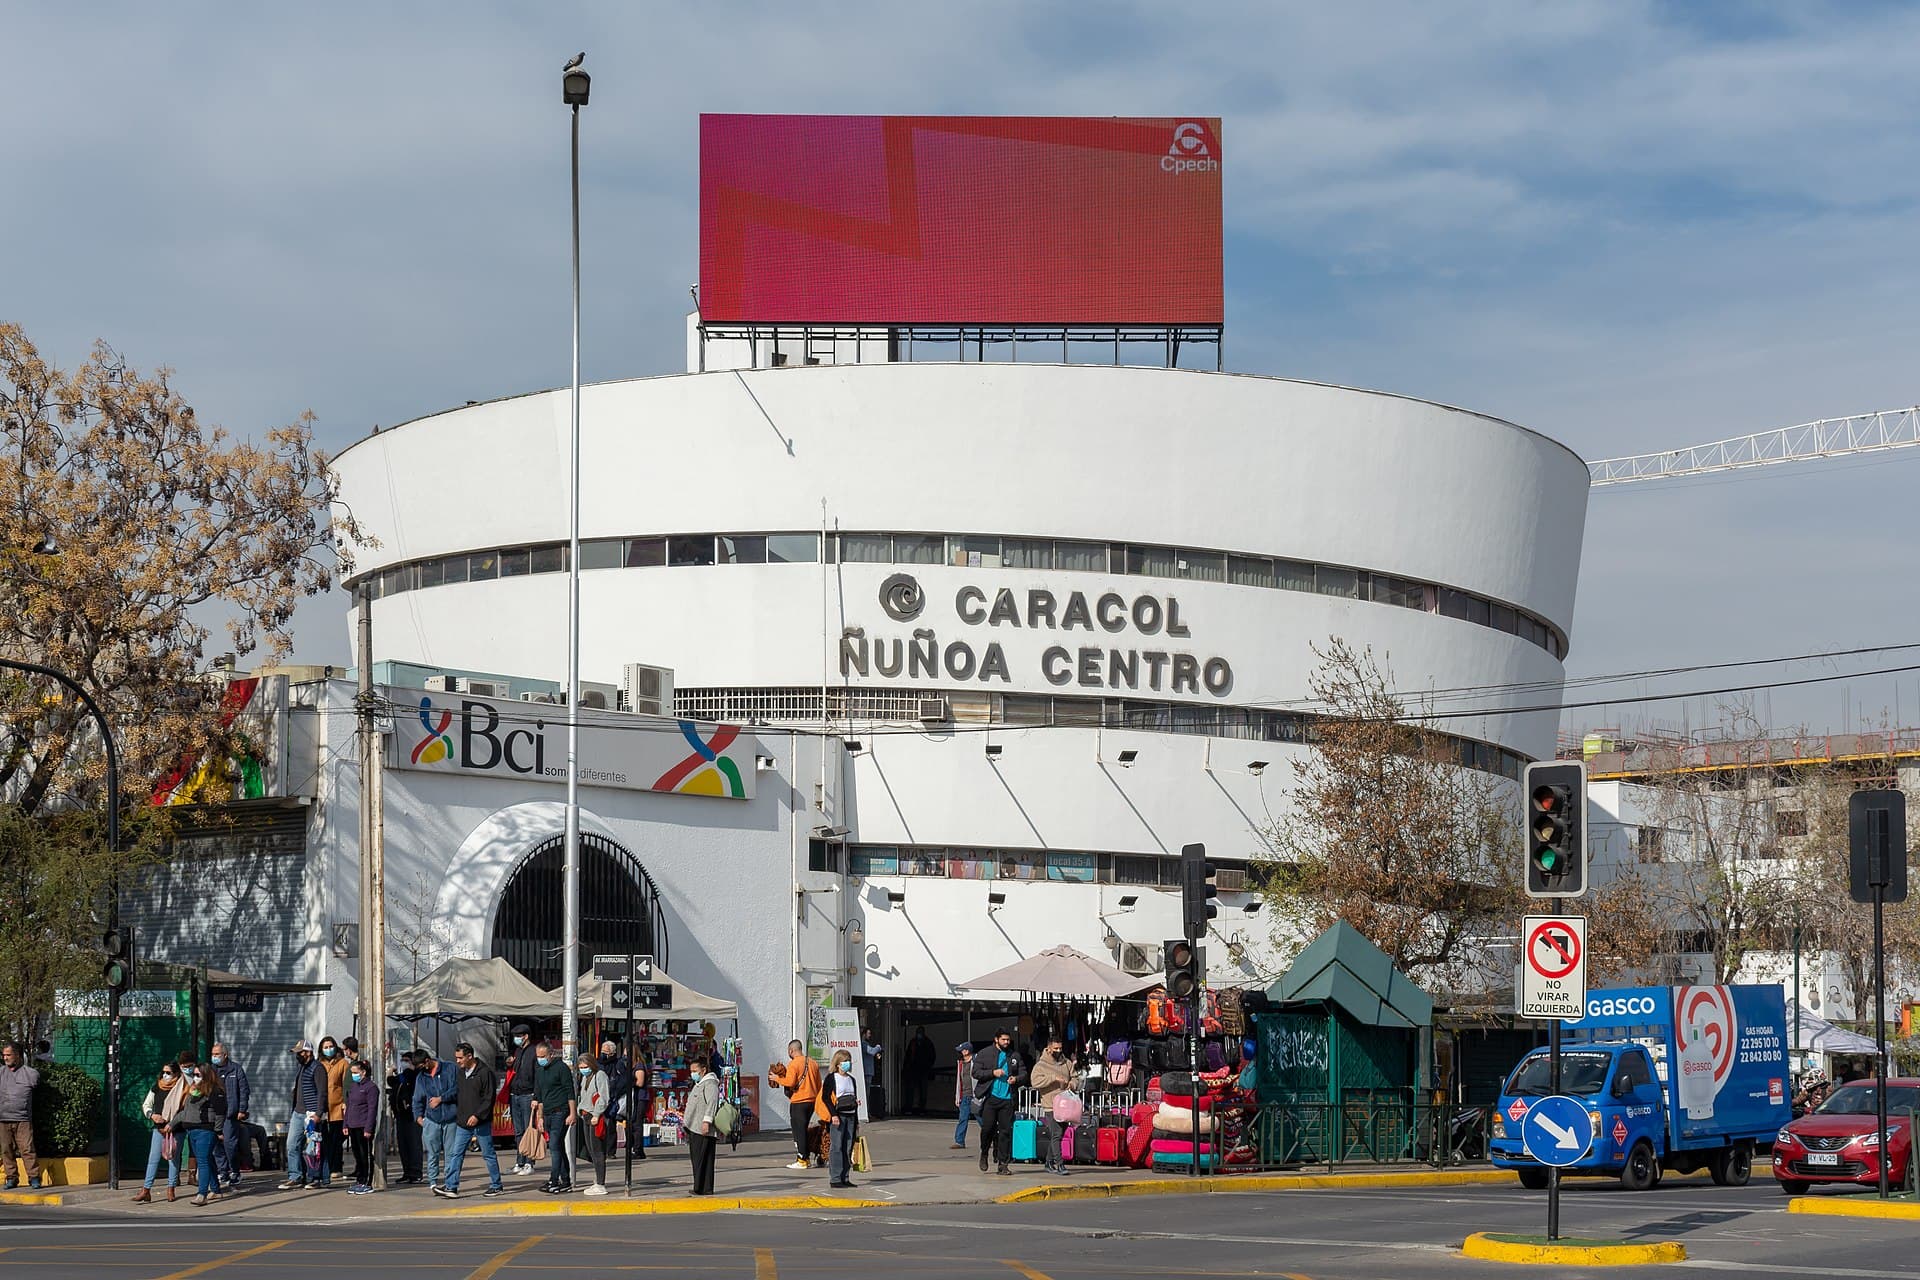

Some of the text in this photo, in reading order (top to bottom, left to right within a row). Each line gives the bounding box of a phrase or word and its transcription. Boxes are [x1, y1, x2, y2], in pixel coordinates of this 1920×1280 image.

[1161, 156, 1218, 176] Cpech
[955, 585, 1191, 638] CARACOL
[839, 627, 1234, 697] ÑUÑOA CENTRO
[461, 700, 544, 774] Bci
[545, 767, 627, 783] som diferentes
[1545, 980, 1562, 989] NO
[1537, 992, 1569, 1001] VIRAR
[1526, 1003, 1581, 1014] IZQUIERDA
[1745, 1026, 1774, 1035] GAS HOGAR
[837, 1040, 846, 1048] DEL
[1741, 1037, 1779, 1049] 22 295 10 10
[1740, 1050, 1782, 1063] 22 842 80 80
